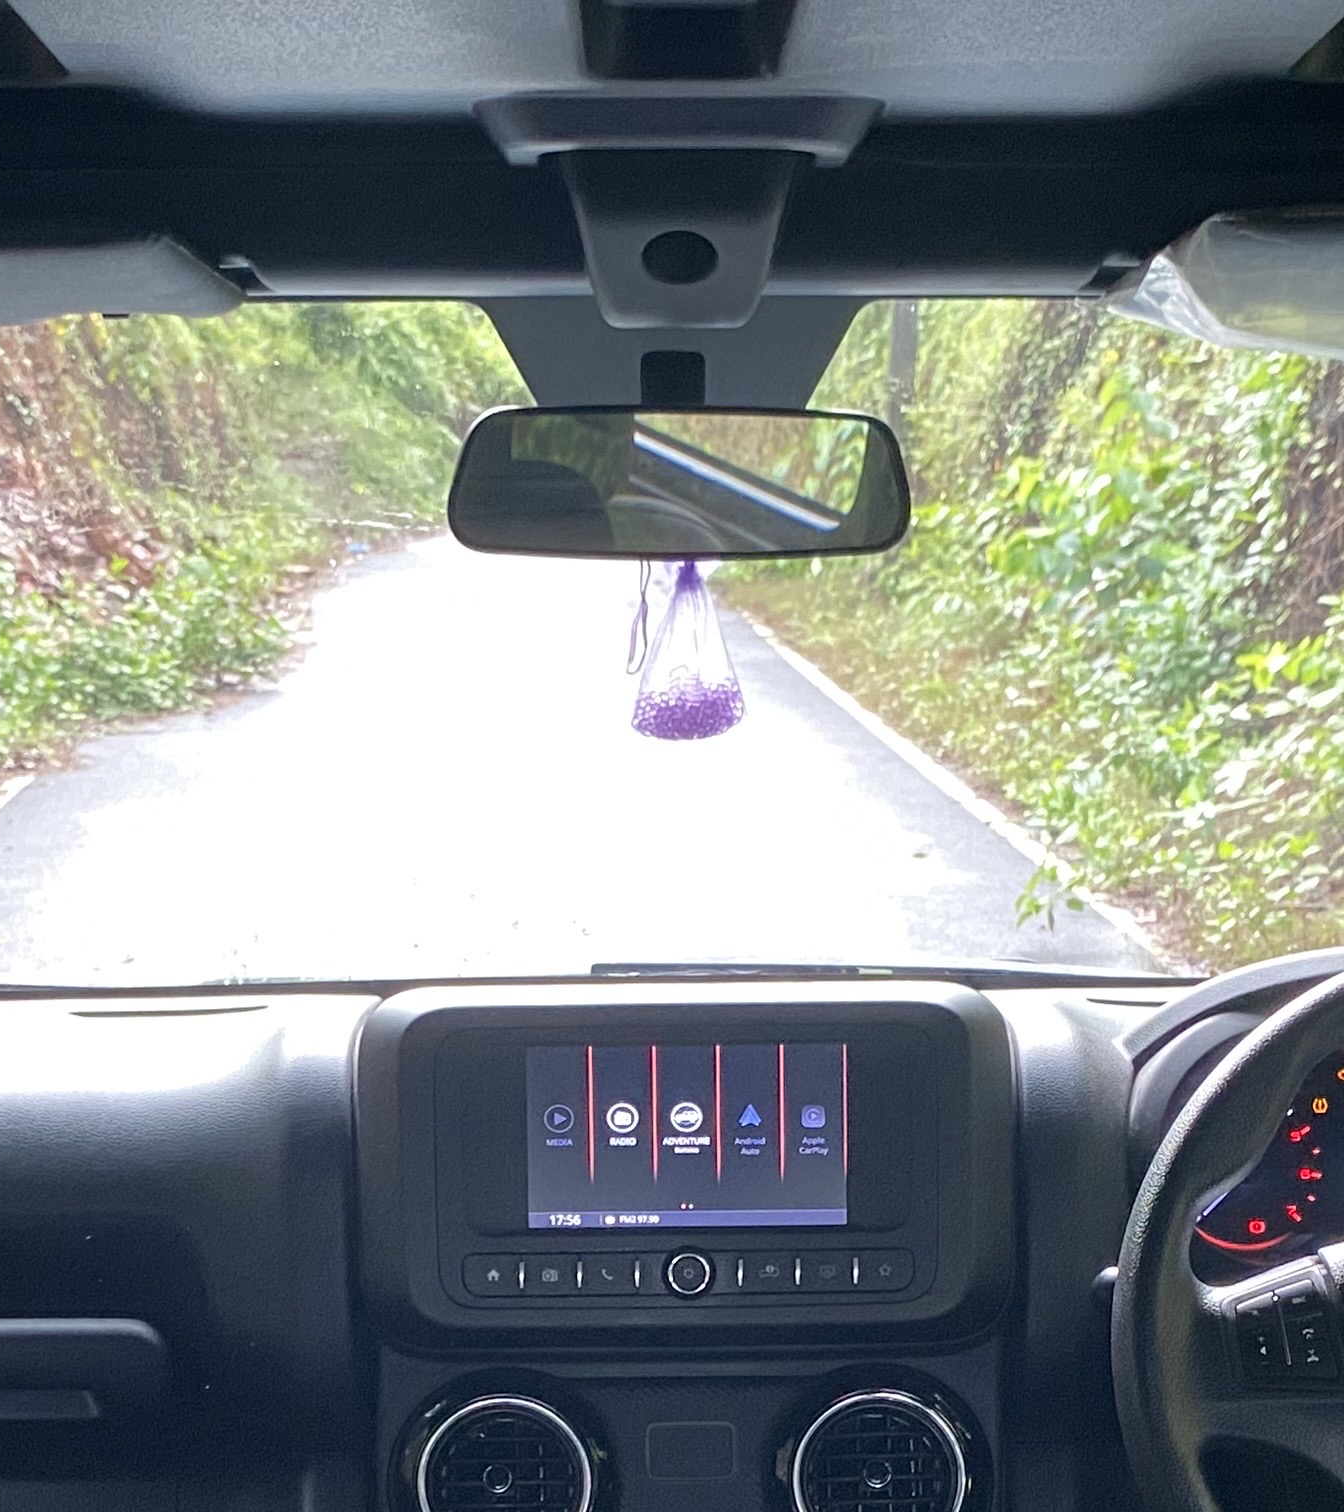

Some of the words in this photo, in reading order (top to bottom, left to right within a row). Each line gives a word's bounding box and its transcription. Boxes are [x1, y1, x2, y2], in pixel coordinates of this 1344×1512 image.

[609, 1137, 637, 1146] RADIO
[662, 1136, 711, 1146] ADVENTURE
[734, 1137, 766, 1146] Android
[802, 1136, 825, 1146] Apple
[740, 1147, 760, 1156] Auto
[798, 1147, 829, 1156] CarPlay
[549, 1214, 581, 1226] 17:56
